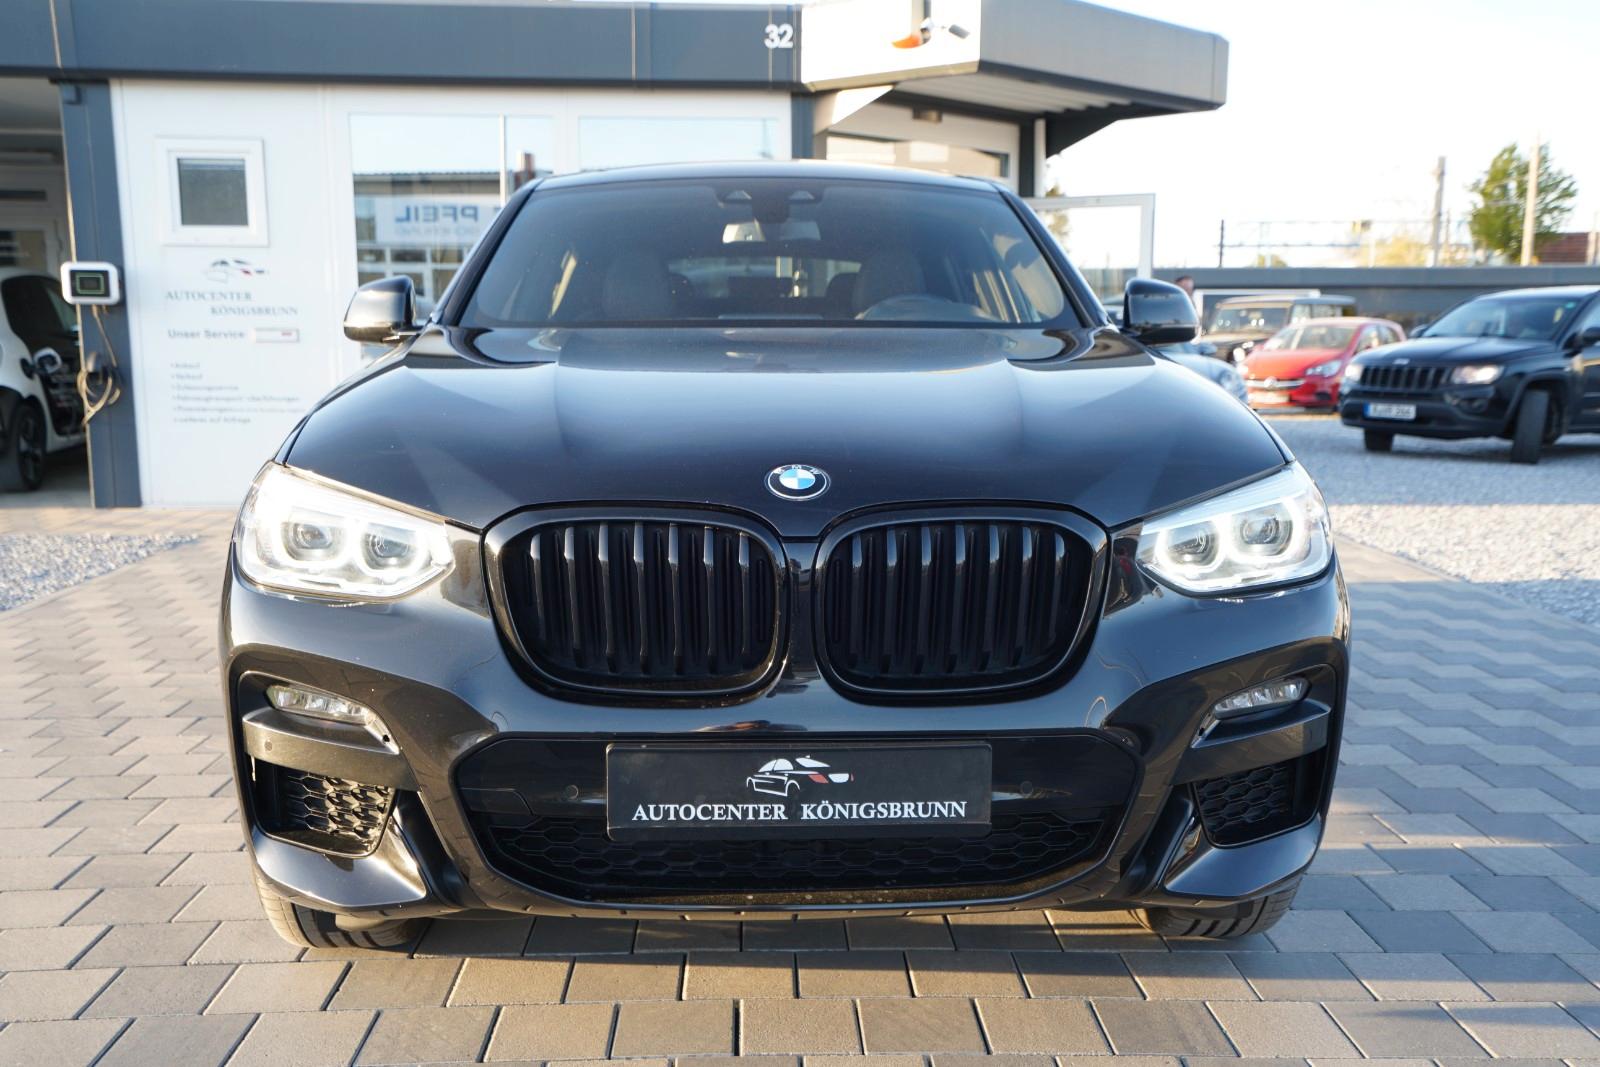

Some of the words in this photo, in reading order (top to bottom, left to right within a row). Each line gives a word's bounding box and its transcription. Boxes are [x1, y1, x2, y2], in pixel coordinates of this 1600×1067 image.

[764, 23, 793, 48] 32
[166, 291, 252, 301] AUTOCENTER
[167, 328, 201, 338] Unser
[631, 803, 788, 821] AUTOCENTER
[800, 800, 967, 820] KÖNIGSBRUNN
